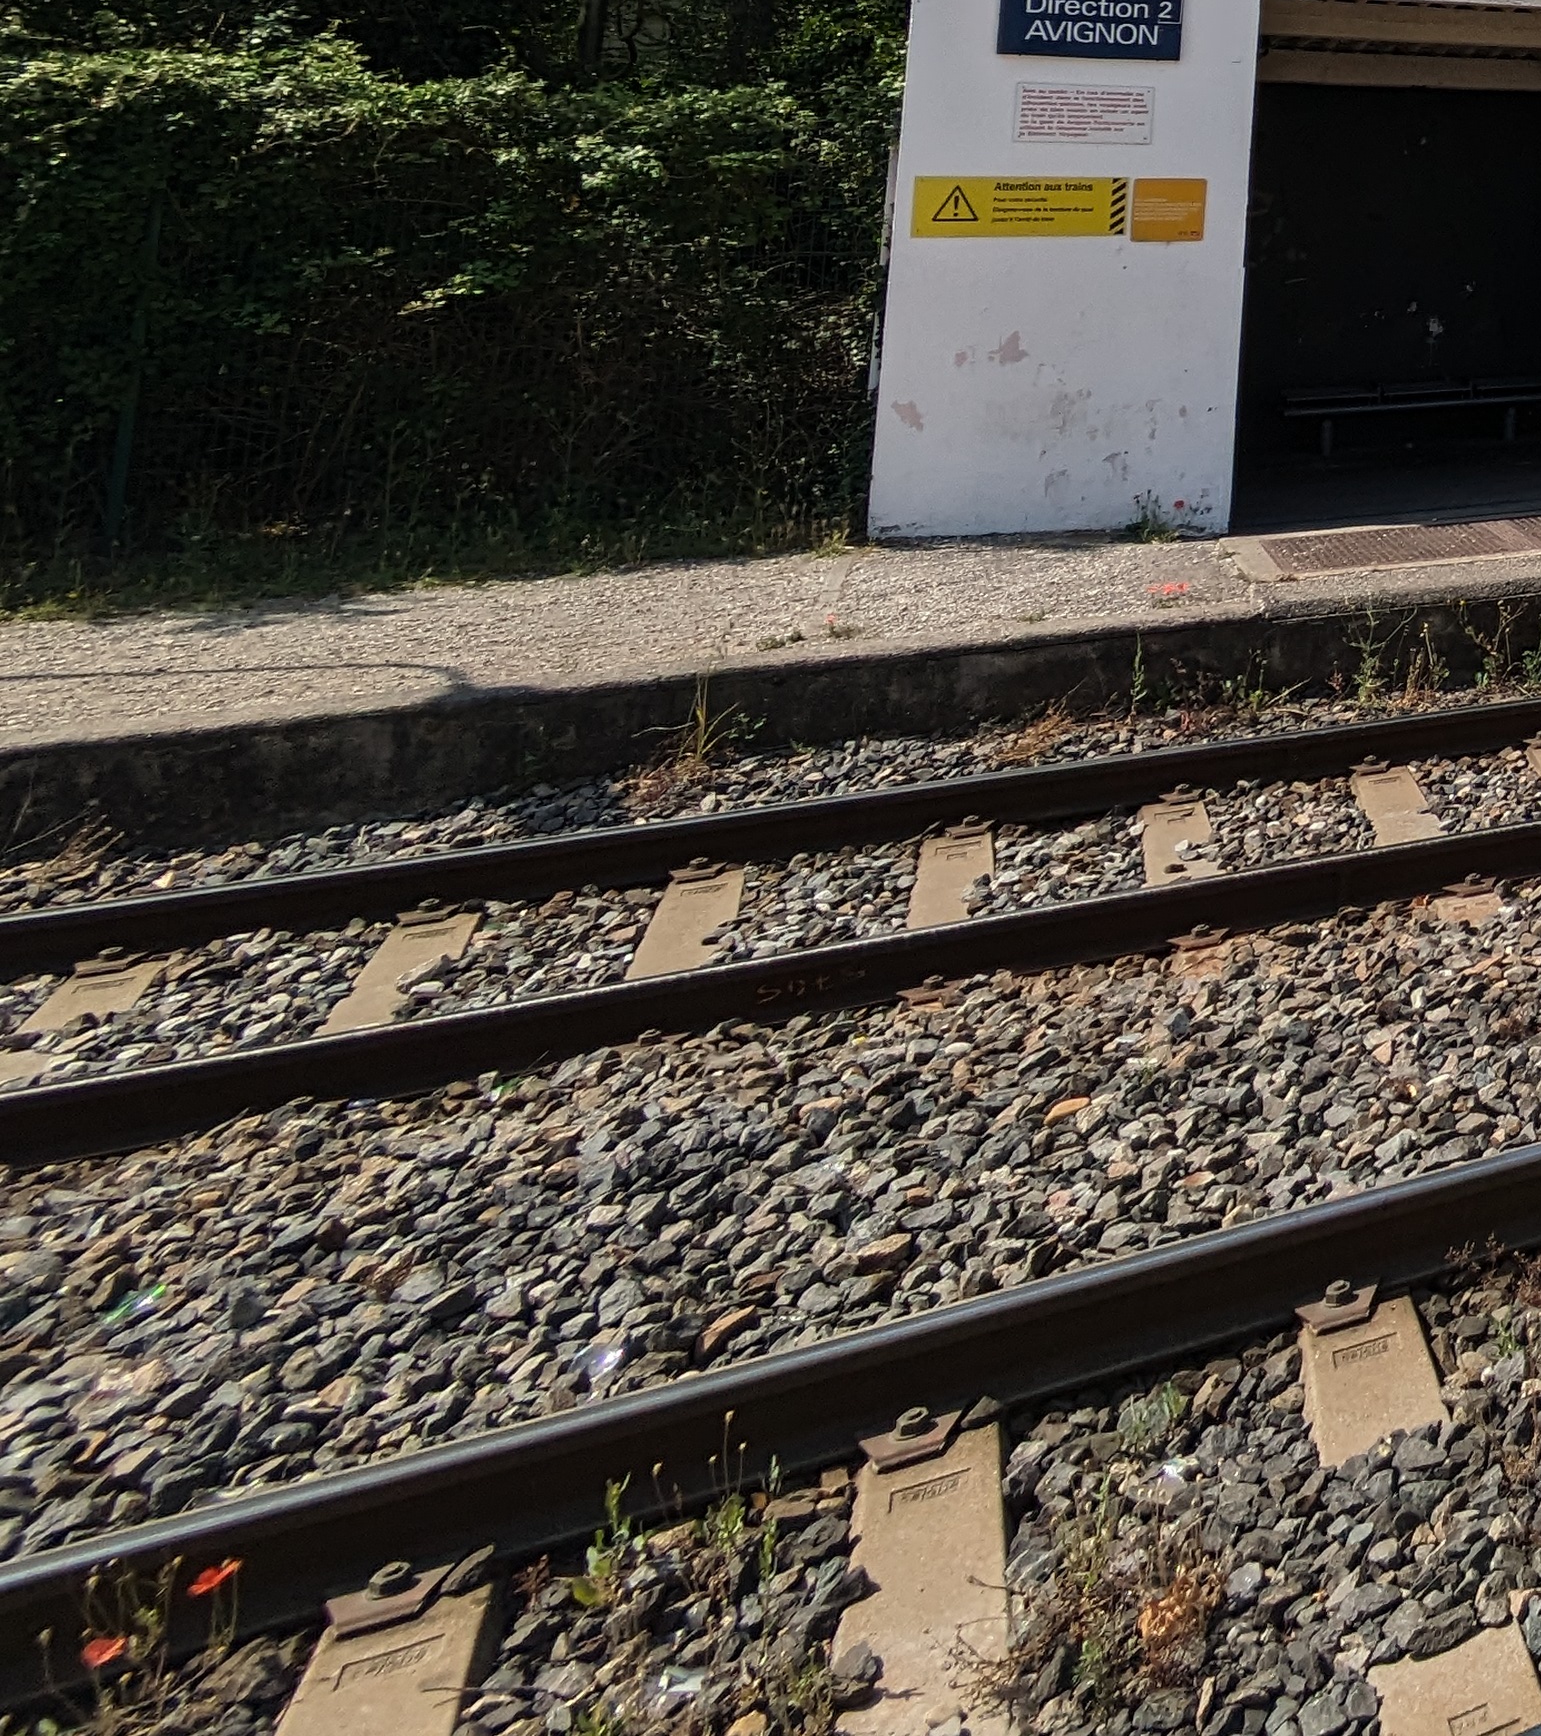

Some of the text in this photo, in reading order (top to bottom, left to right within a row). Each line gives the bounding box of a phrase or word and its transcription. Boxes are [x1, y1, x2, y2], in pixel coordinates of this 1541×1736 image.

[1157, 1, 1172, 19] 2
[1024, 19, 1159, 46] AVIGNON
[994, 182, 1093, 192] Attention aux trains
